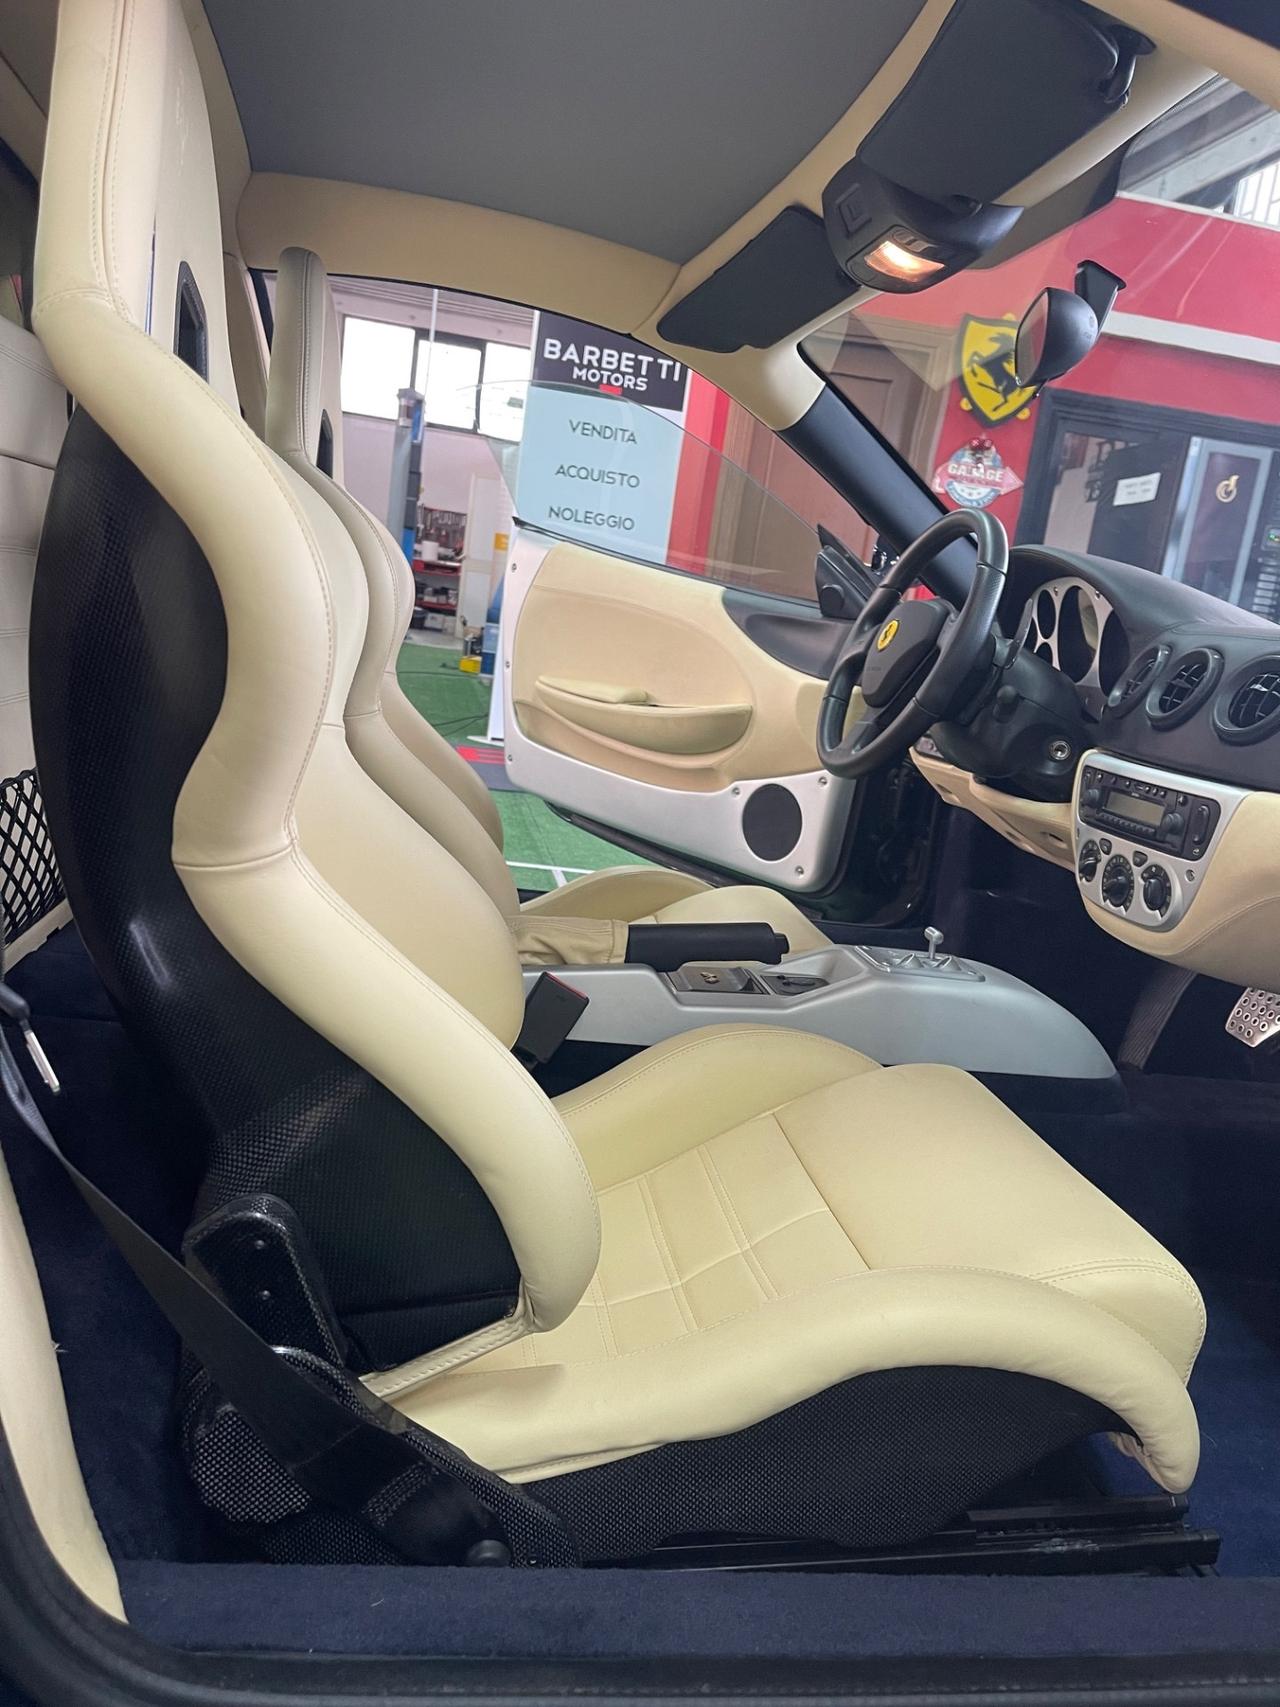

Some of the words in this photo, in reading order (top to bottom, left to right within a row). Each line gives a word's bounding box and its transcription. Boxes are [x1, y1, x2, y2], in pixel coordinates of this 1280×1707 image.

[544, 338, 681, 381] BARBETTI
[572, 366, 648, 391] MOTORS
[569, 419, 637, 444] VENDITA
[555, 464, 640, 488] ACQUISTO
[548, 506, 634, 530] NOLEGGIO
